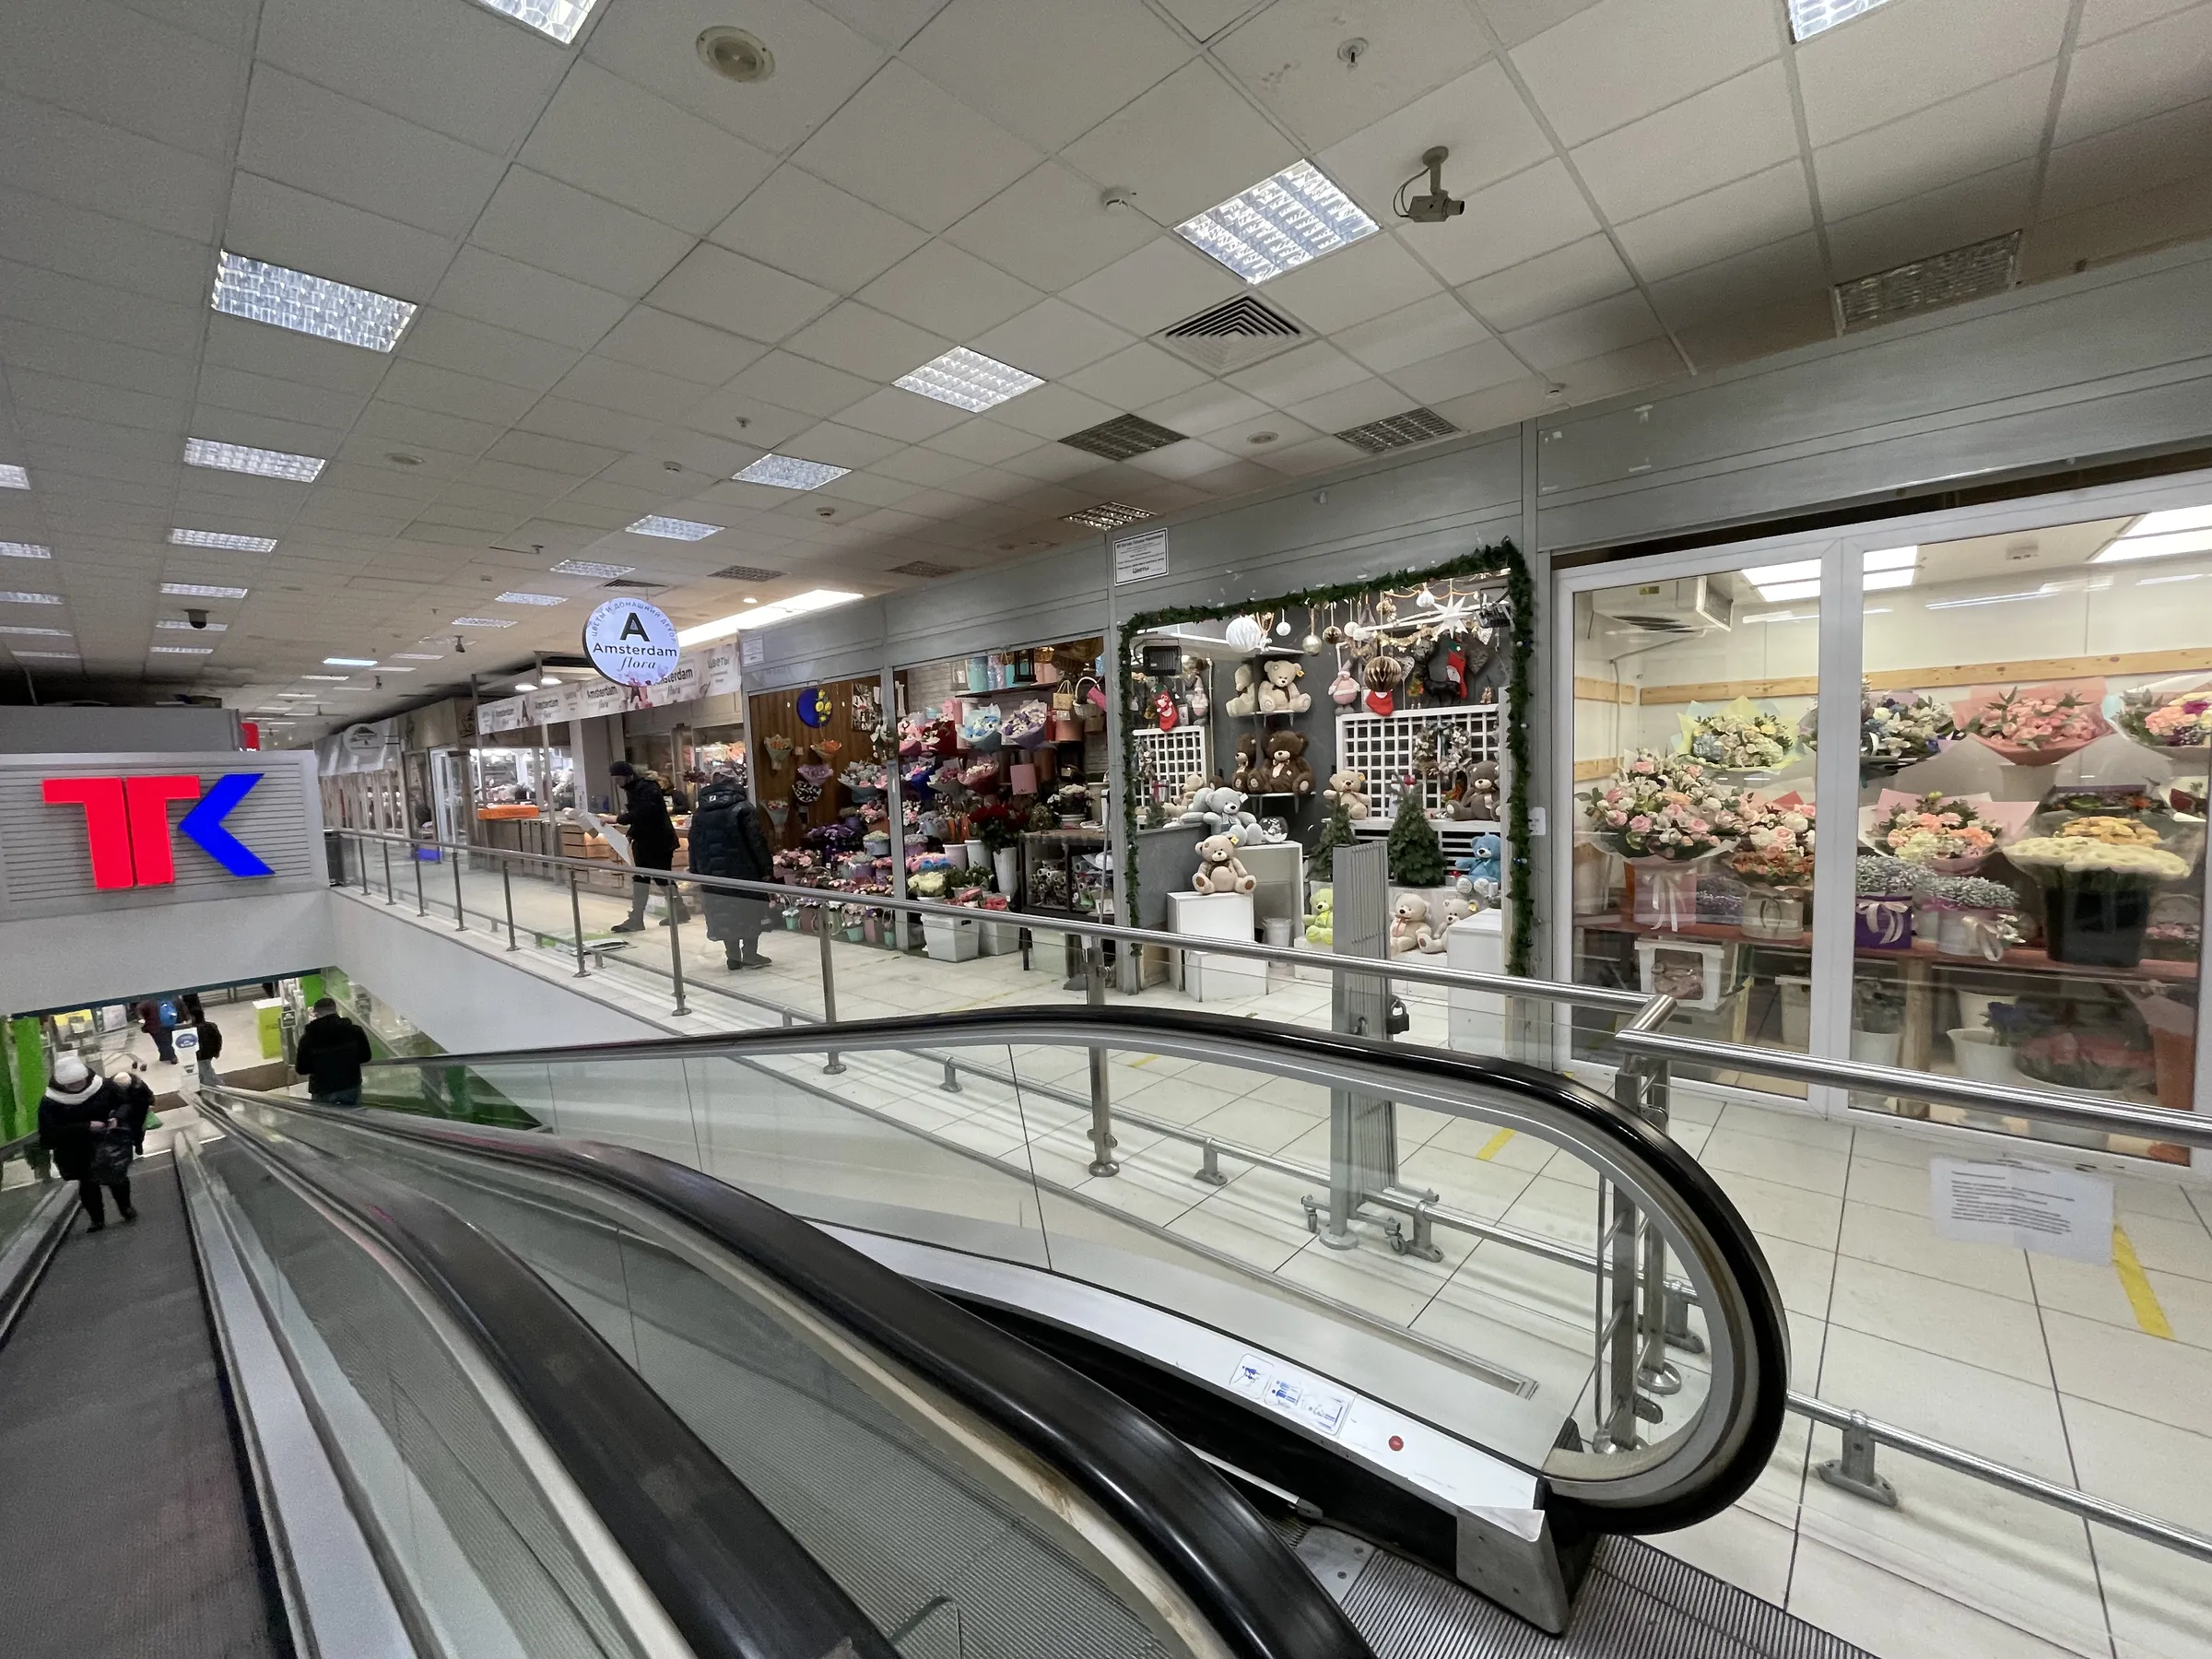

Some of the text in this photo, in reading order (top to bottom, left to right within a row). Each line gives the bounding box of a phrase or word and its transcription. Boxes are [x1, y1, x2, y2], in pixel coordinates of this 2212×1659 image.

[591, 612, 606, 638] ЦВЕТЫ
[660, 618, 676, 642] ДЕКОР
[619, 612, 651, 642] A
[593, 642, 677, 657] Amsterdam
[617, 656, 656, 672] flora
[706, 656, 730, 669] цветы
